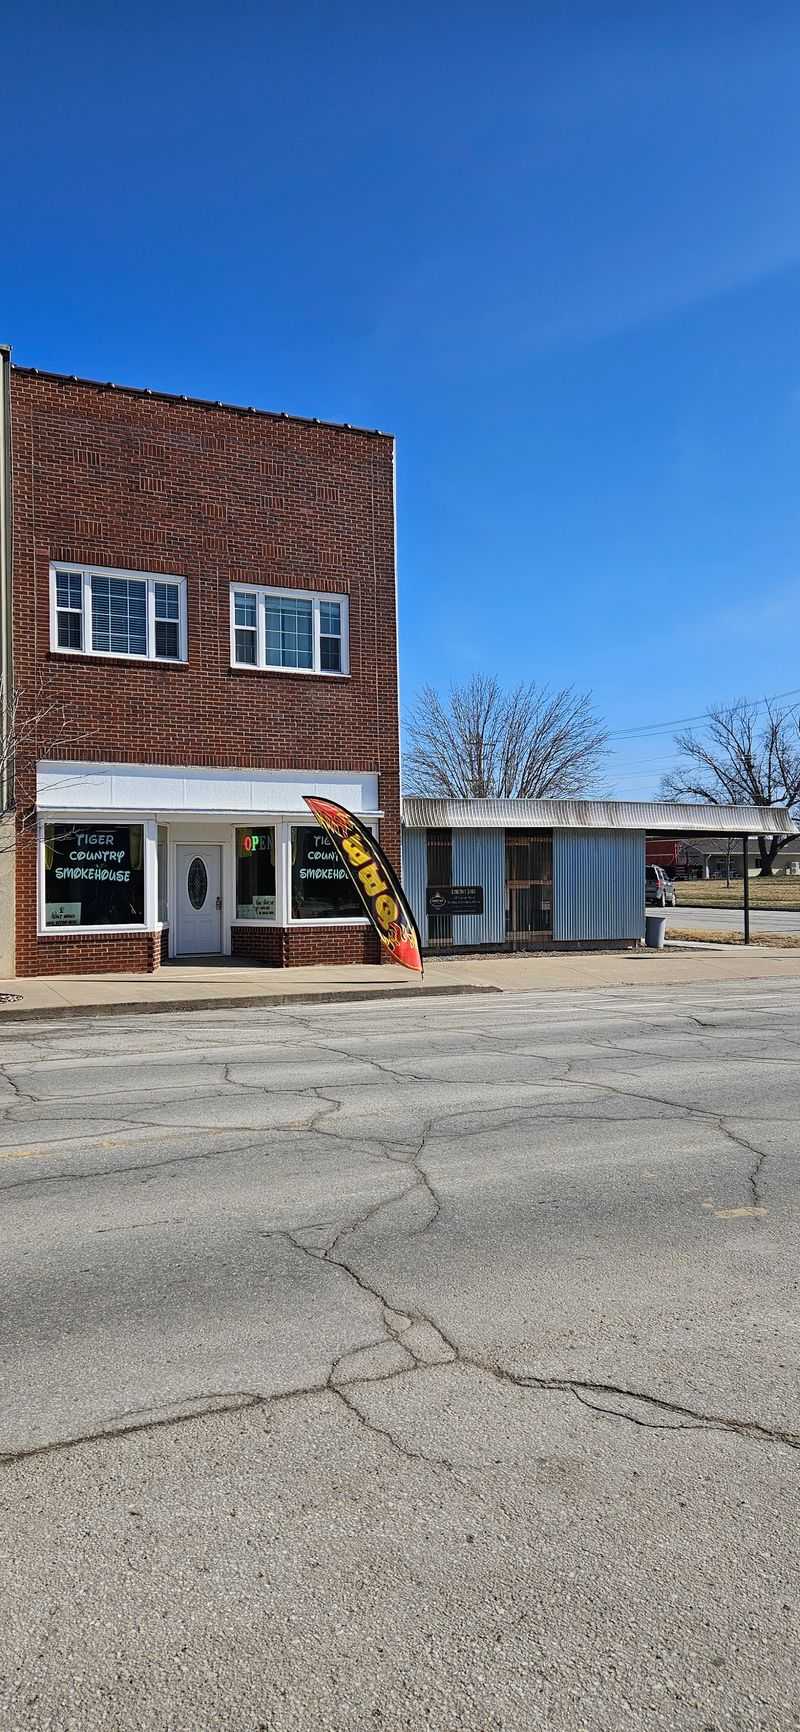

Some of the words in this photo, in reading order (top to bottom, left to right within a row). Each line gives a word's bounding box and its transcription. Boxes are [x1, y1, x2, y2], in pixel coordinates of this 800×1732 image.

[76, 833, 114, 846] TIGER
[243, 835, 272, 851] OPEN
[313, 834, 331, 848] TIG
[69, 850, 125, 863] COUNTRY
[307, 850, 339, 862] COUN
[55, 867, 131, 882] SMOKEHOUSE
[299, 867, 349, 880] SMOKEHO
